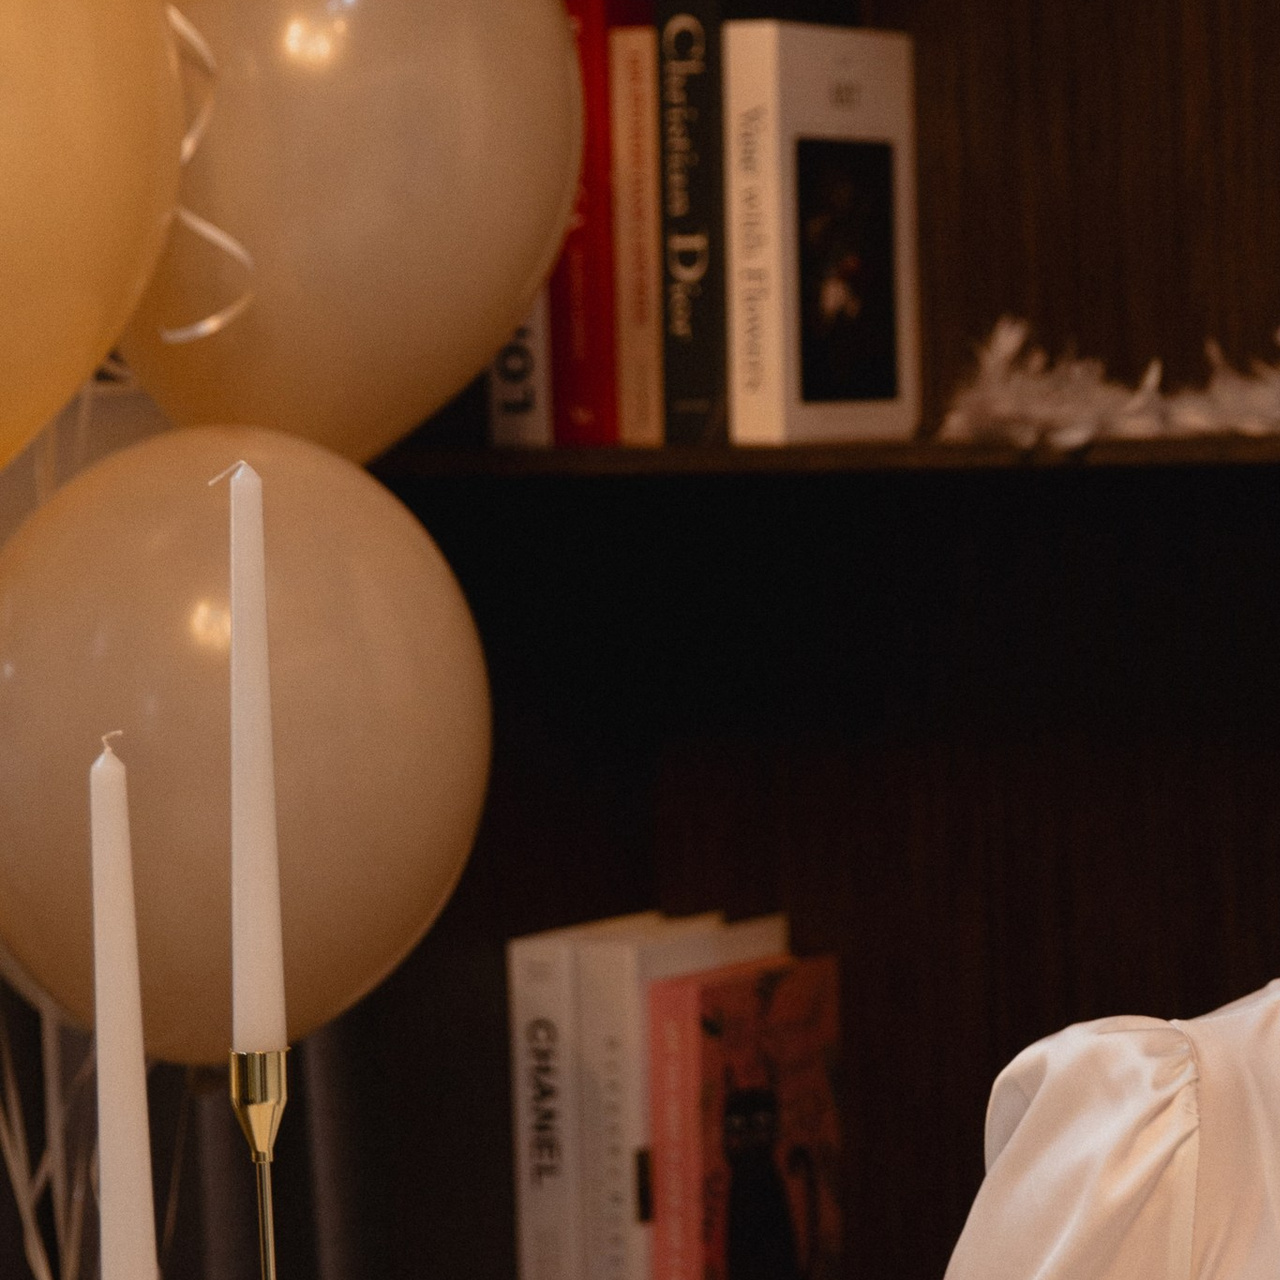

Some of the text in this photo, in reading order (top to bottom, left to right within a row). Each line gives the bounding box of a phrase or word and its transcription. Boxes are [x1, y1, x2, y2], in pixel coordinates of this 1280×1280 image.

[661, 13, 709, 341] Christian Dior
[528, 1018, 559, 1187] CHANEL
